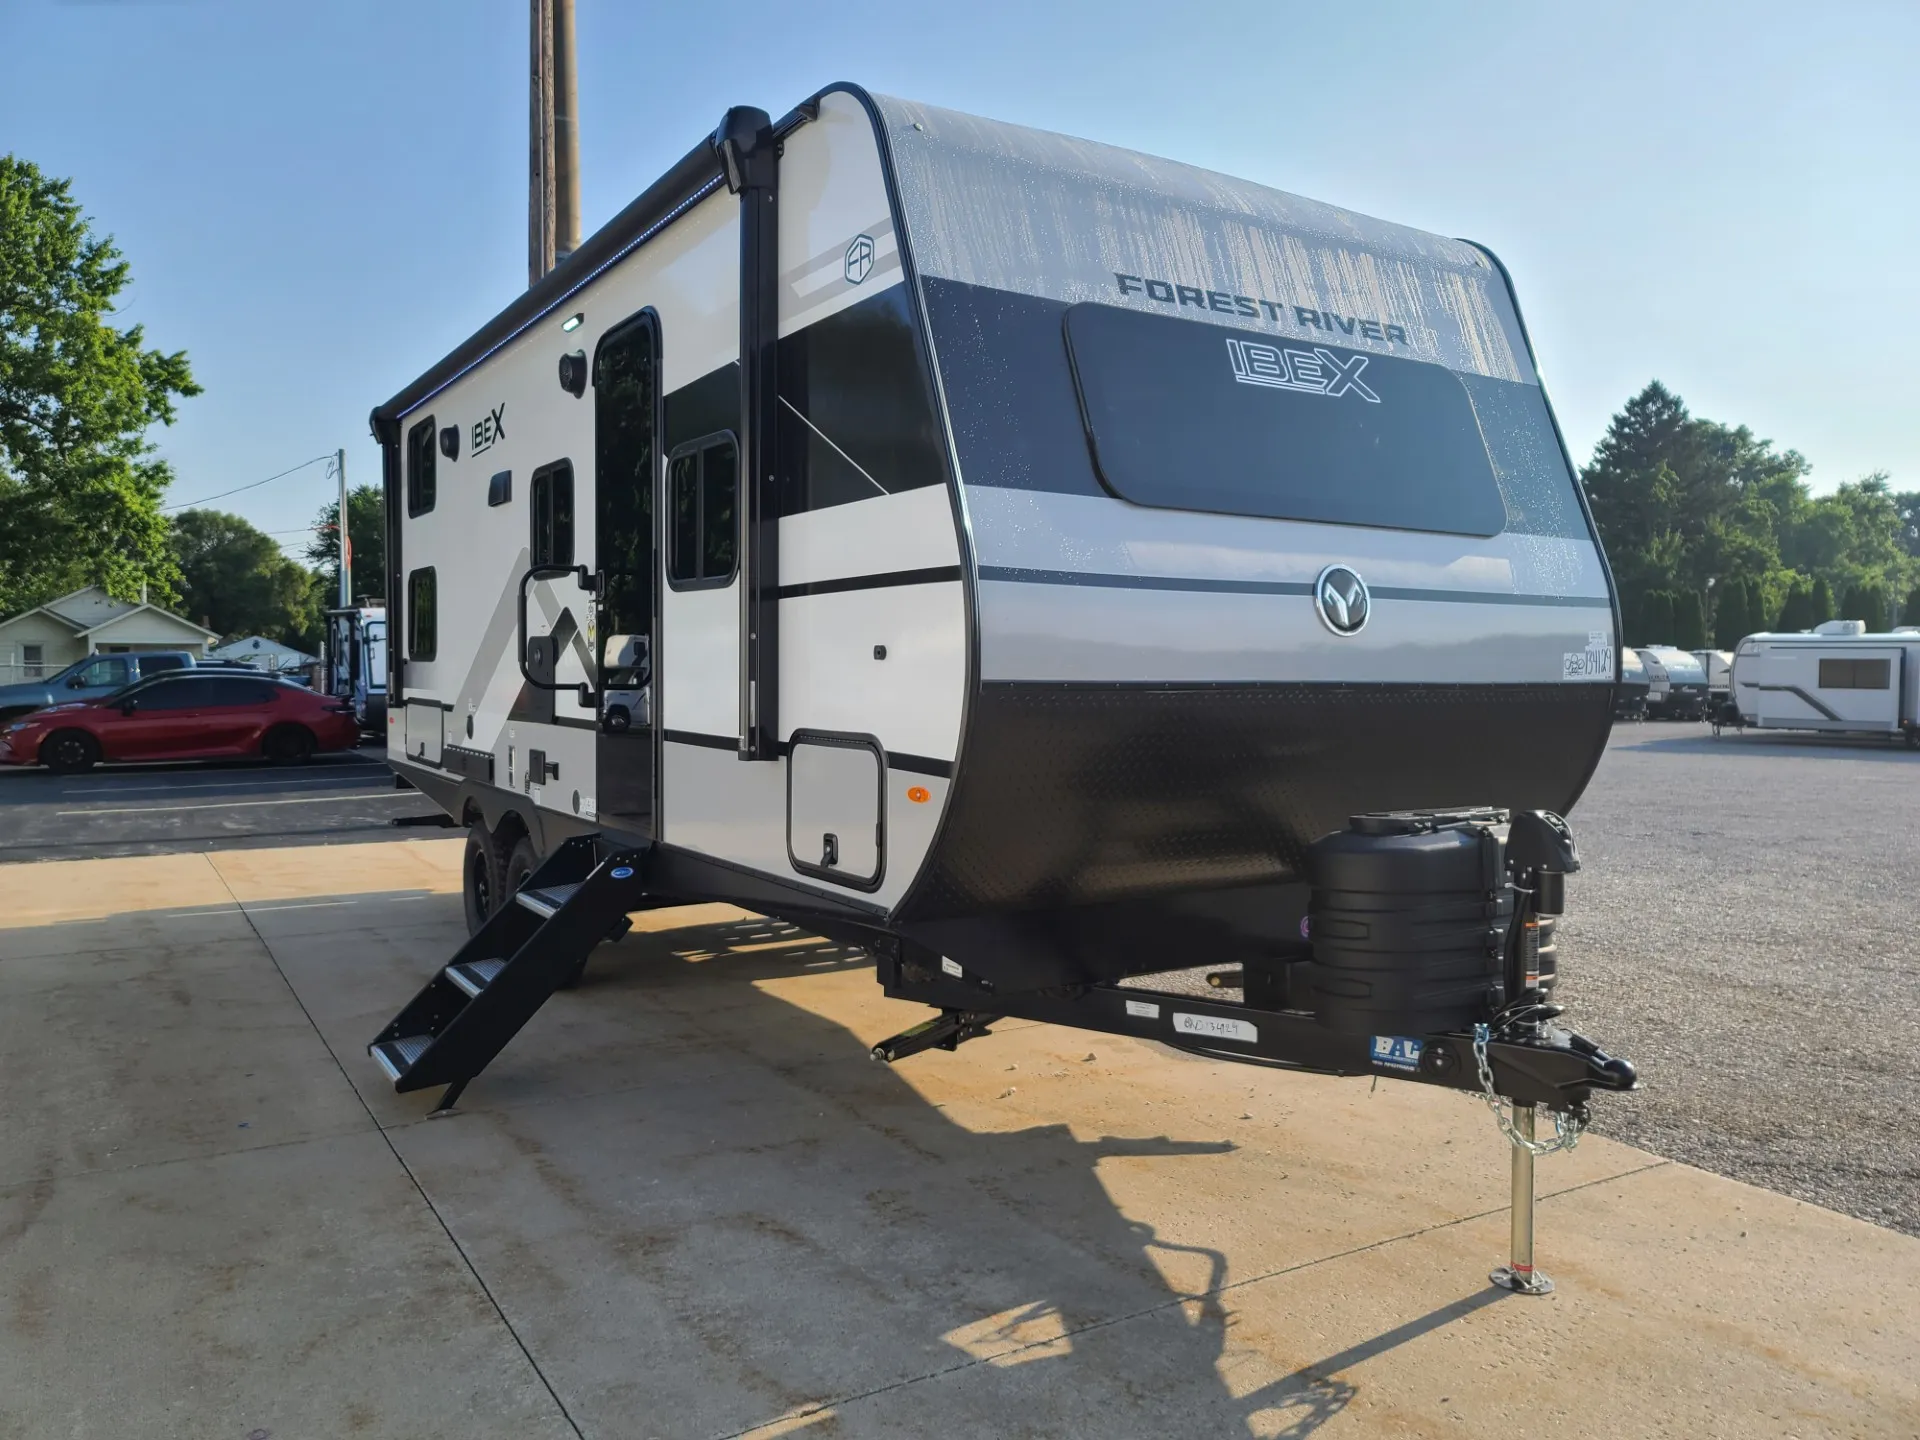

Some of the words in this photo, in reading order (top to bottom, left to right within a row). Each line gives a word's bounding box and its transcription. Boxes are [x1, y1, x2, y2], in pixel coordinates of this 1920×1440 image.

[1113, 272, 1283, 323] FOREST
[1292, 304, 1409, 346] RIVER
[1226, 338, 1381, 403] IBEX
[471, 402, 506, 451] IBEX
